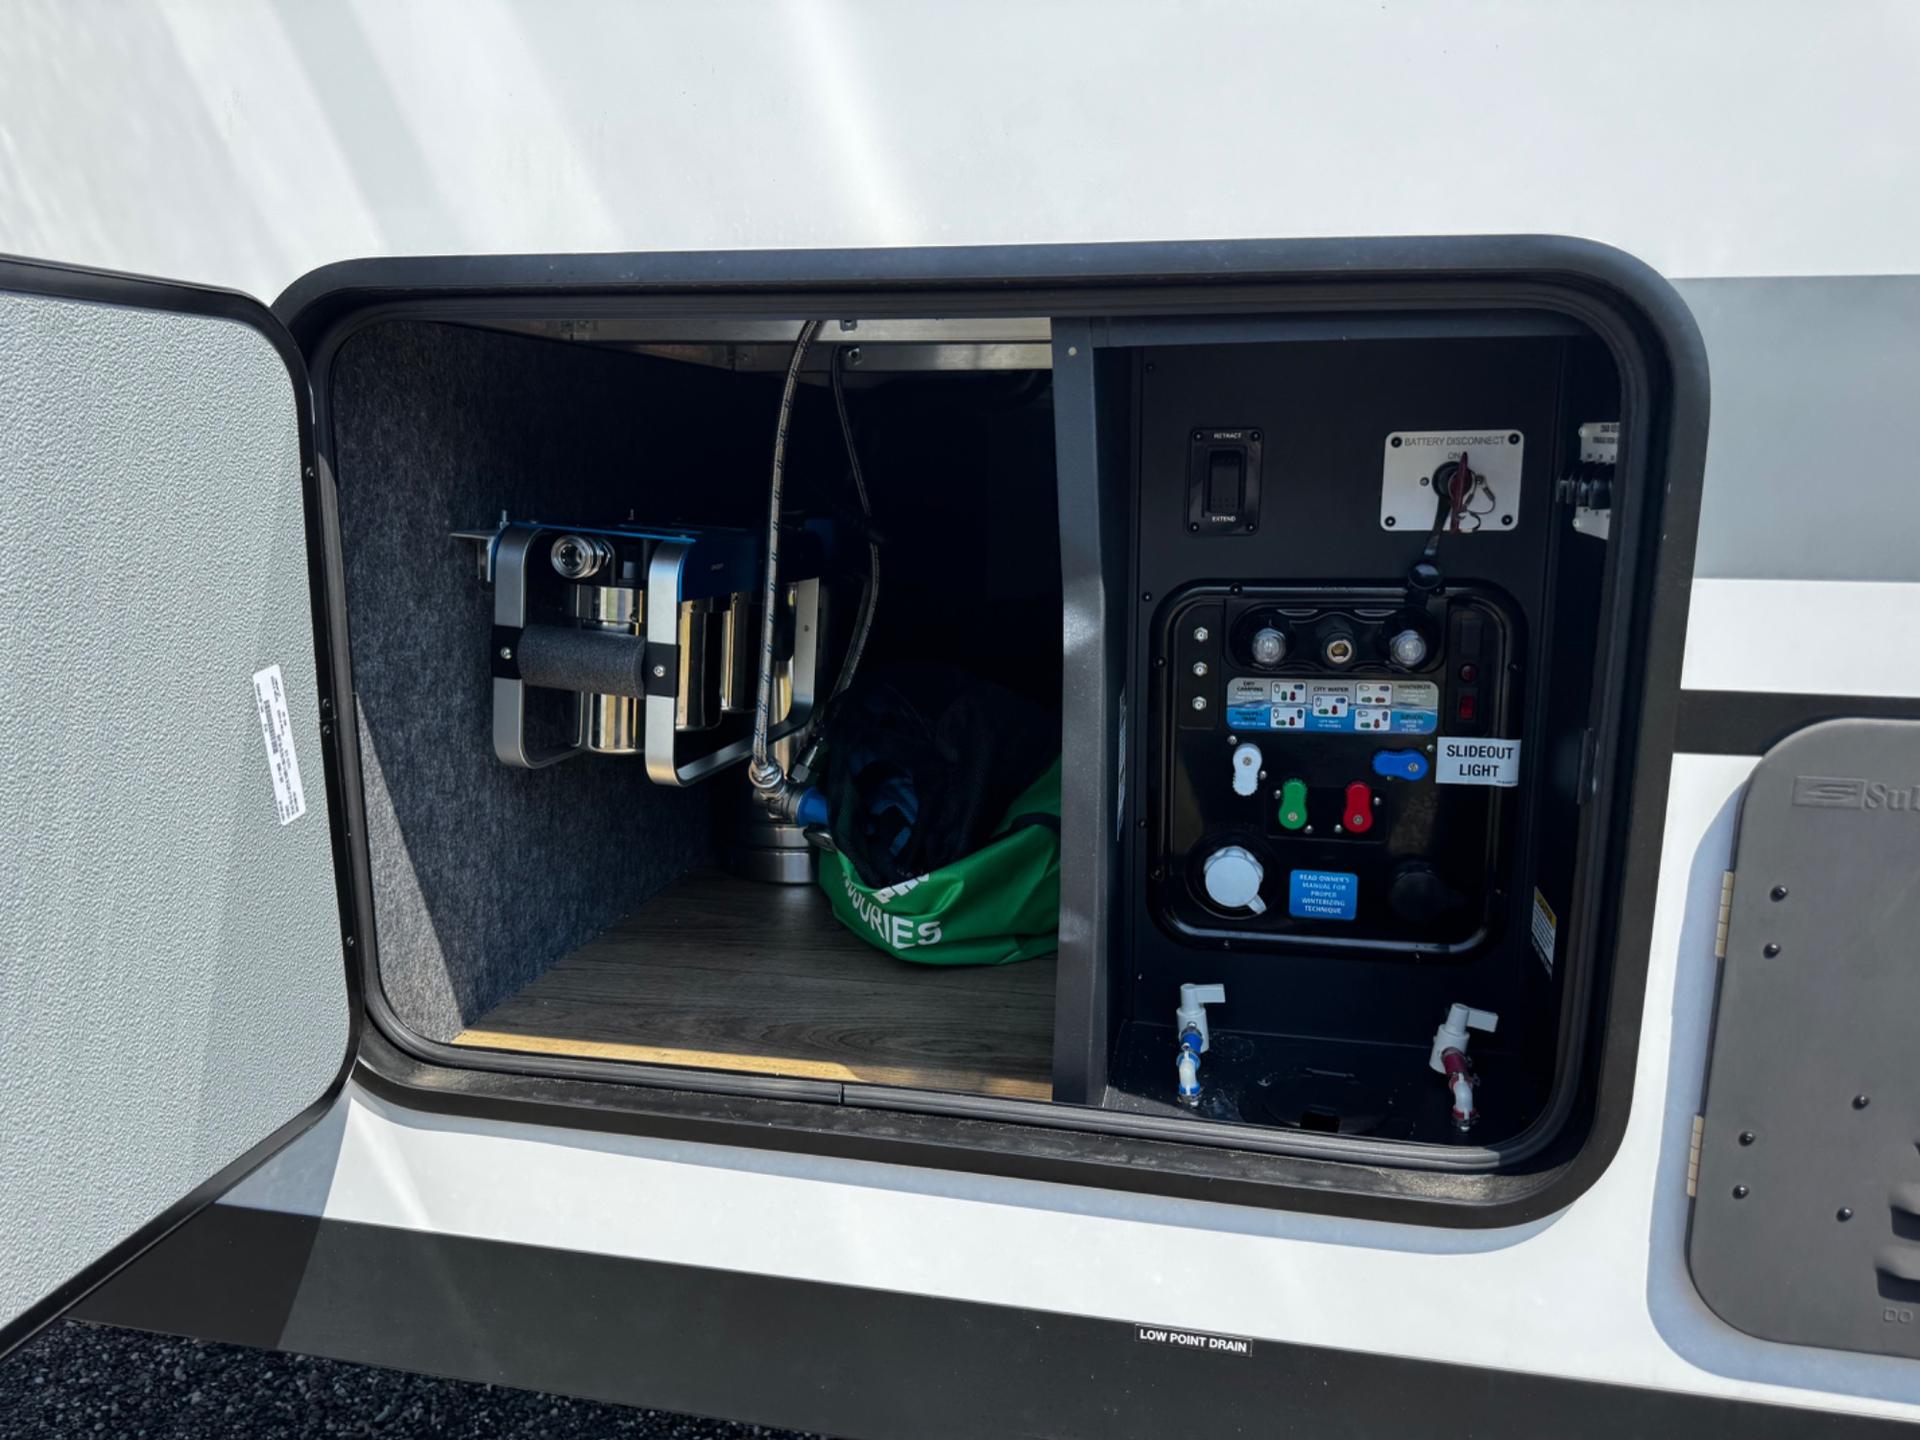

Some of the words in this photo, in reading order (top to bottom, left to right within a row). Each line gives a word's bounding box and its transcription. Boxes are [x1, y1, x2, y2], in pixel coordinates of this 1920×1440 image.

[1404, 436, 1444, 447] BATTERY
[1446, 435, 1506, 446] DISCONNECT
[1447, 451, 1461, 460] ON
[1446, 744, 1515, 760] SLIDEOUT
[1459, 763, 1500, 777] LIGHT
[1299, 873, 1318, 881] READ
[1302, 881, 1331, 890] MANUAL
[1304, 905, 1342, 914] TECHNIQUE
[1140, 1328, 1168, 1343] LOW
[1169, 1332, 1207, 1348] POINT
[1208, 1337, 1247, 1353] DRAIN
